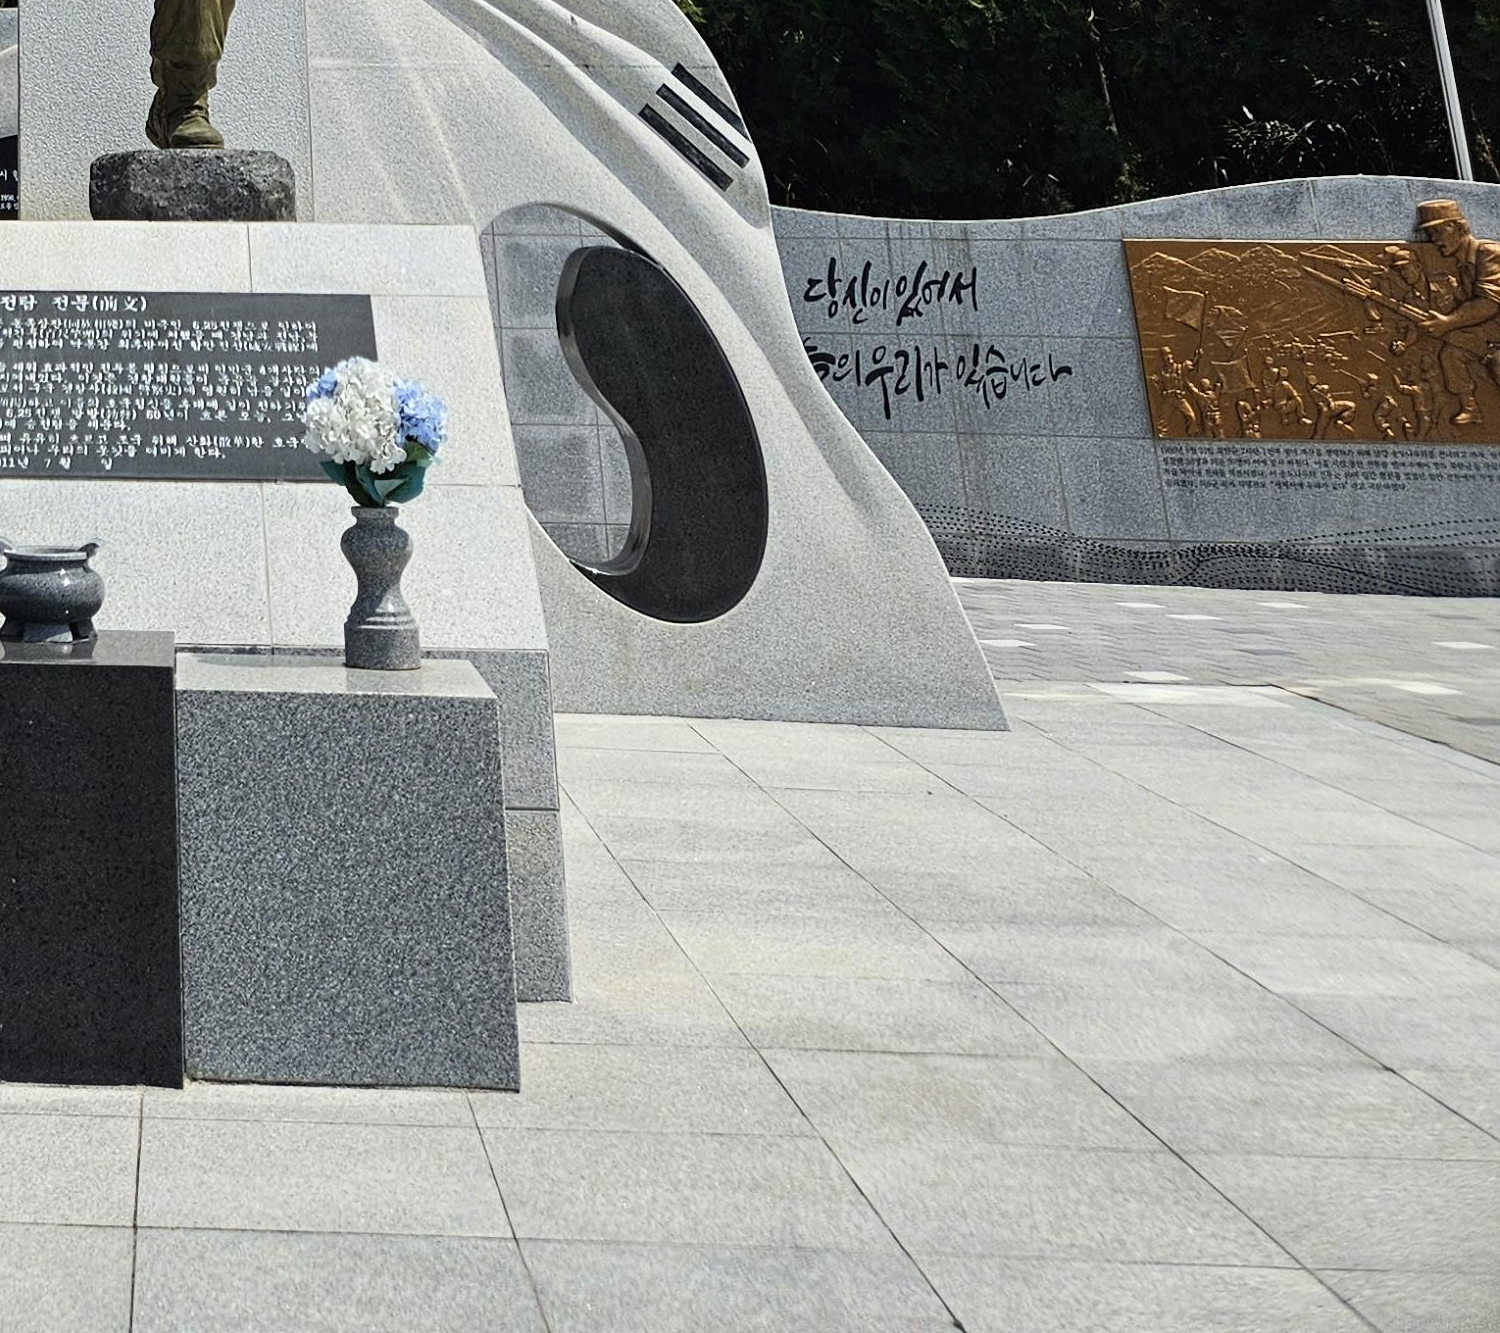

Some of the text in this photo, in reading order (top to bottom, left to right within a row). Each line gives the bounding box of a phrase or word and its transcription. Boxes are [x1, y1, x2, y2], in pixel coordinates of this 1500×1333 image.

[803, 257, 890, 325] 당신이
[864, 345, 949, 420] 우리가
[955, 343, 1073, 410] 있습니다
